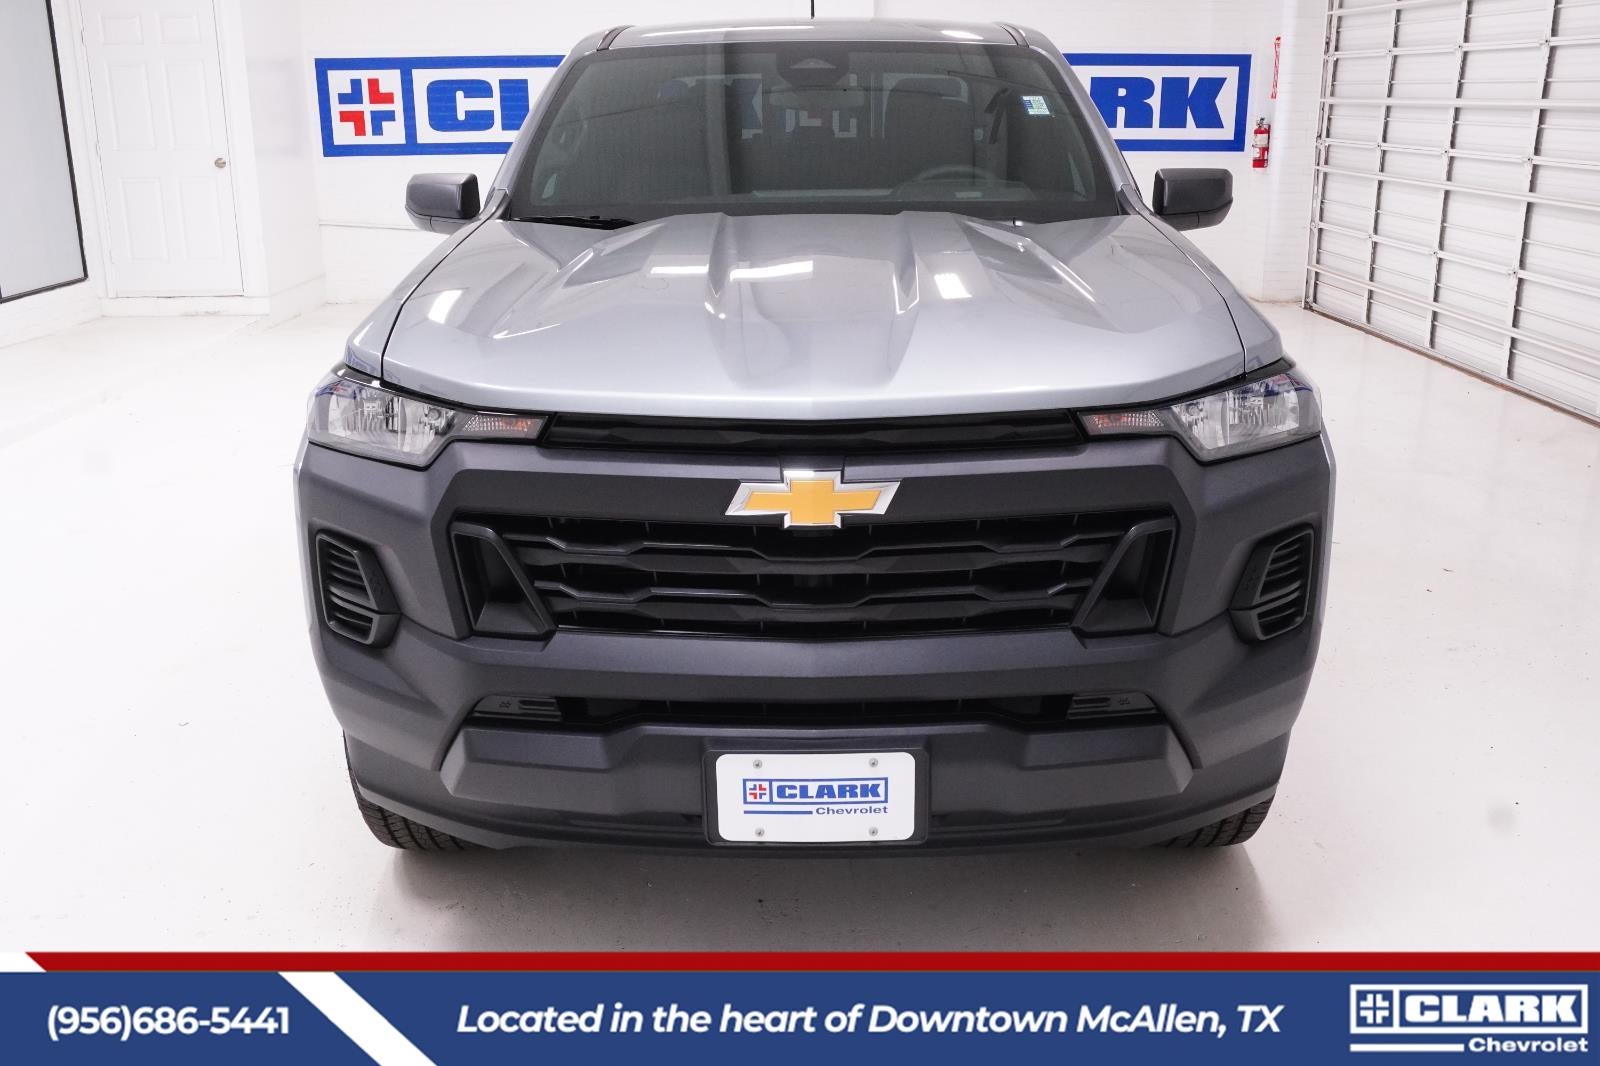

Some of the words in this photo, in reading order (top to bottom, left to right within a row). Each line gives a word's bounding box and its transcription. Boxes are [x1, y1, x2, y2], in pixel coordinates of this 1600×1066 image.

[1090, 76, 1227, 129] RK
[776, 783, 881, 799] CLARK
[815, 805, 889, 815] Chevrolet
